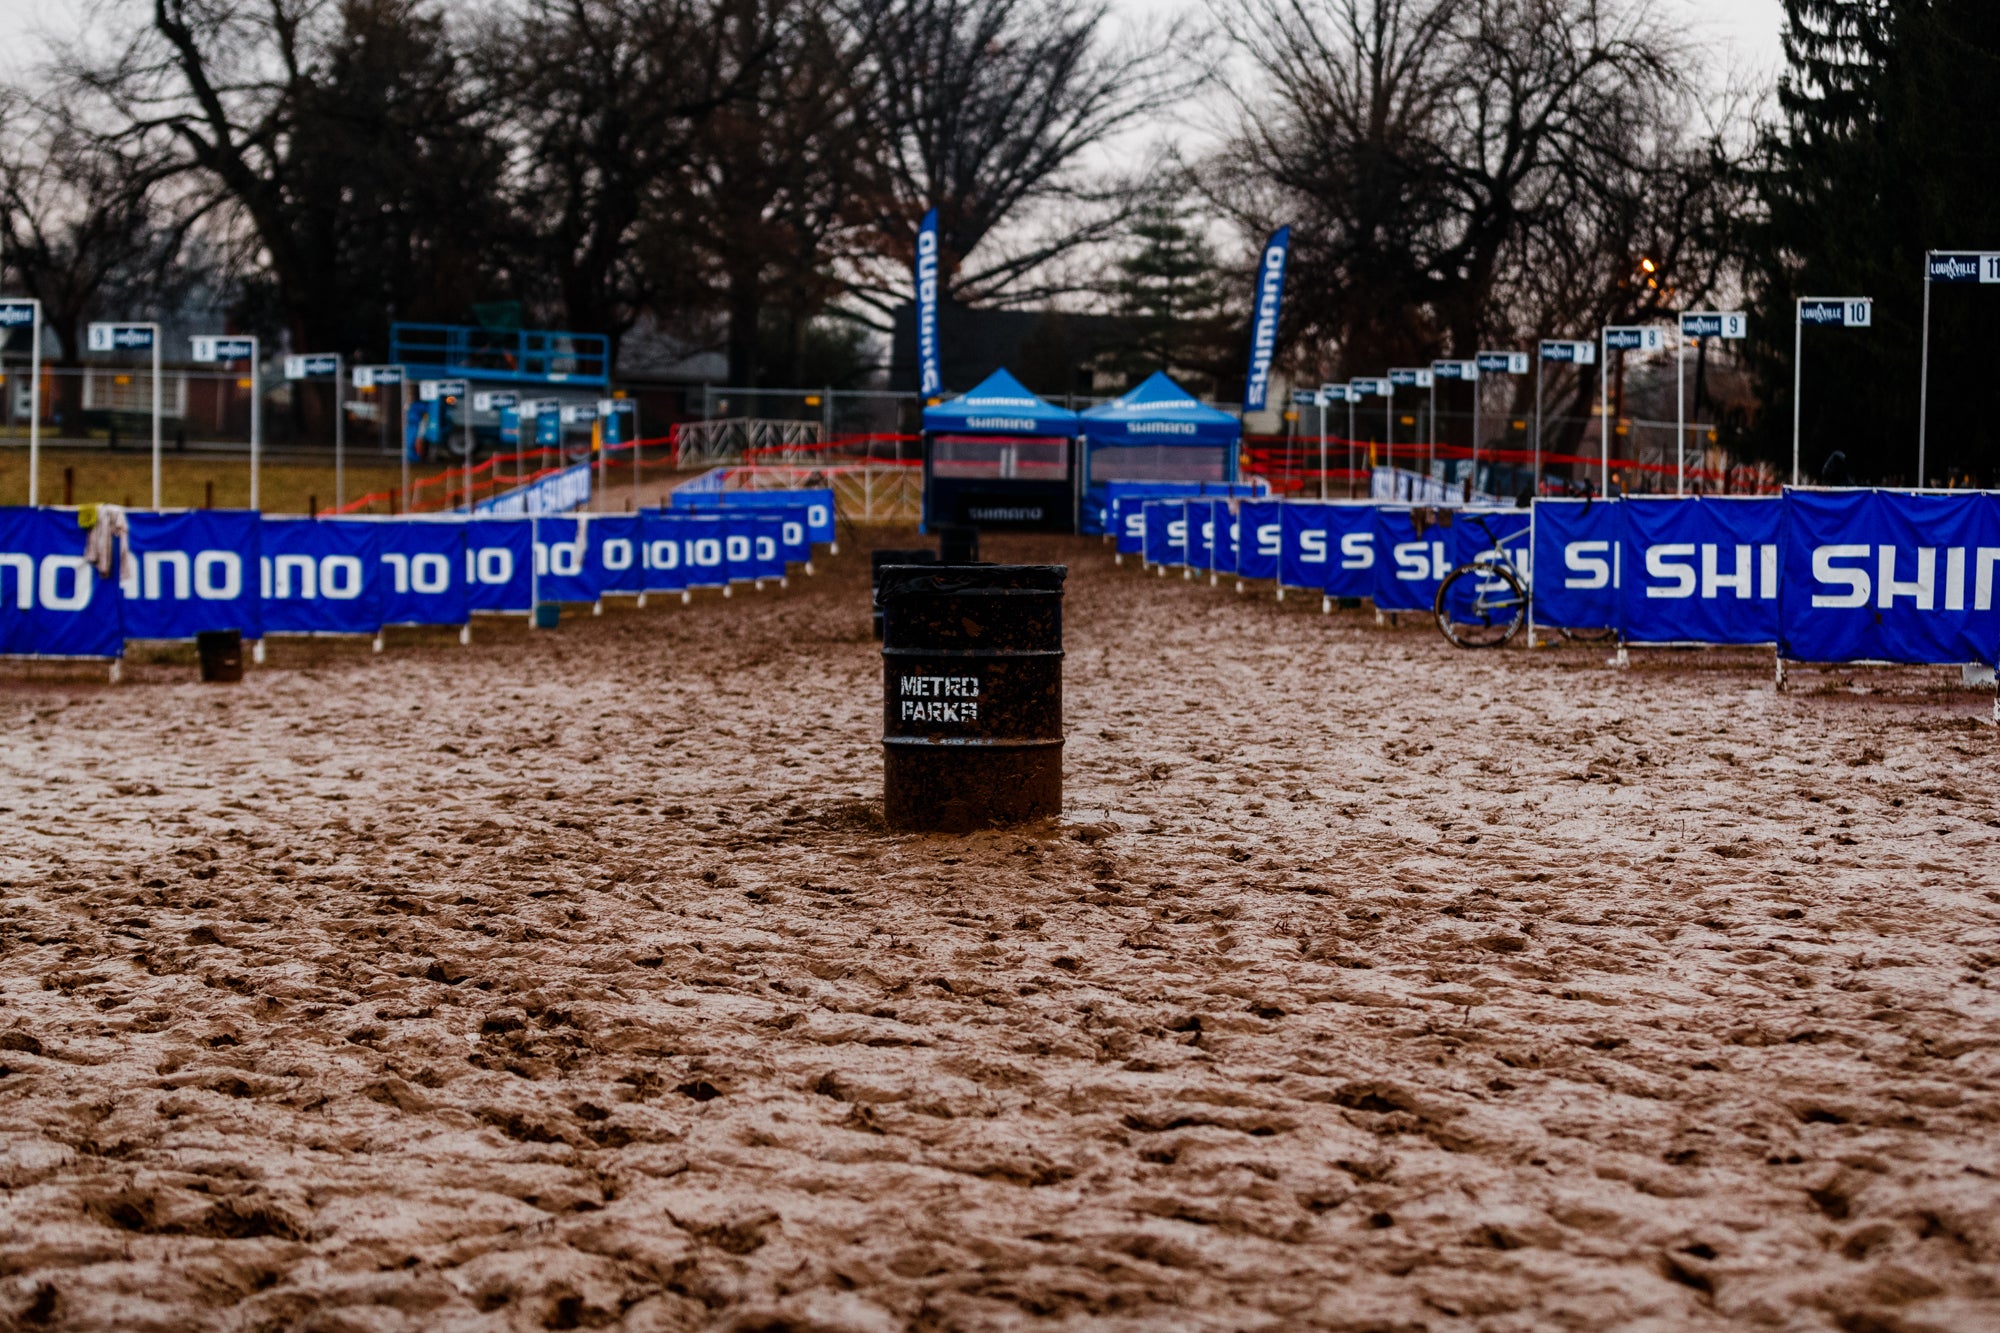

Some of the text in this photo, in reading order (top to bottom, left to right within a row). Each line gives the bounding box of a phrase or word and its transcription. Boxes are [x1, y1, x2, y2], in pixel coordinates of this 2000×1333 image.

[1850, 303, 1865, 322] 10
[1248, 246, 1285, 404] SHIMANO
[1730, 316, 1738, 333] 9
[1580, 344, 1588, 359] 7
[966, 416, 1037, 431] SHIMANO
[1127, 421, 1197, 435] SHIMANO
[1645, 543, 1777, 599] SHI
[900, 676, 979, 697] METRO
